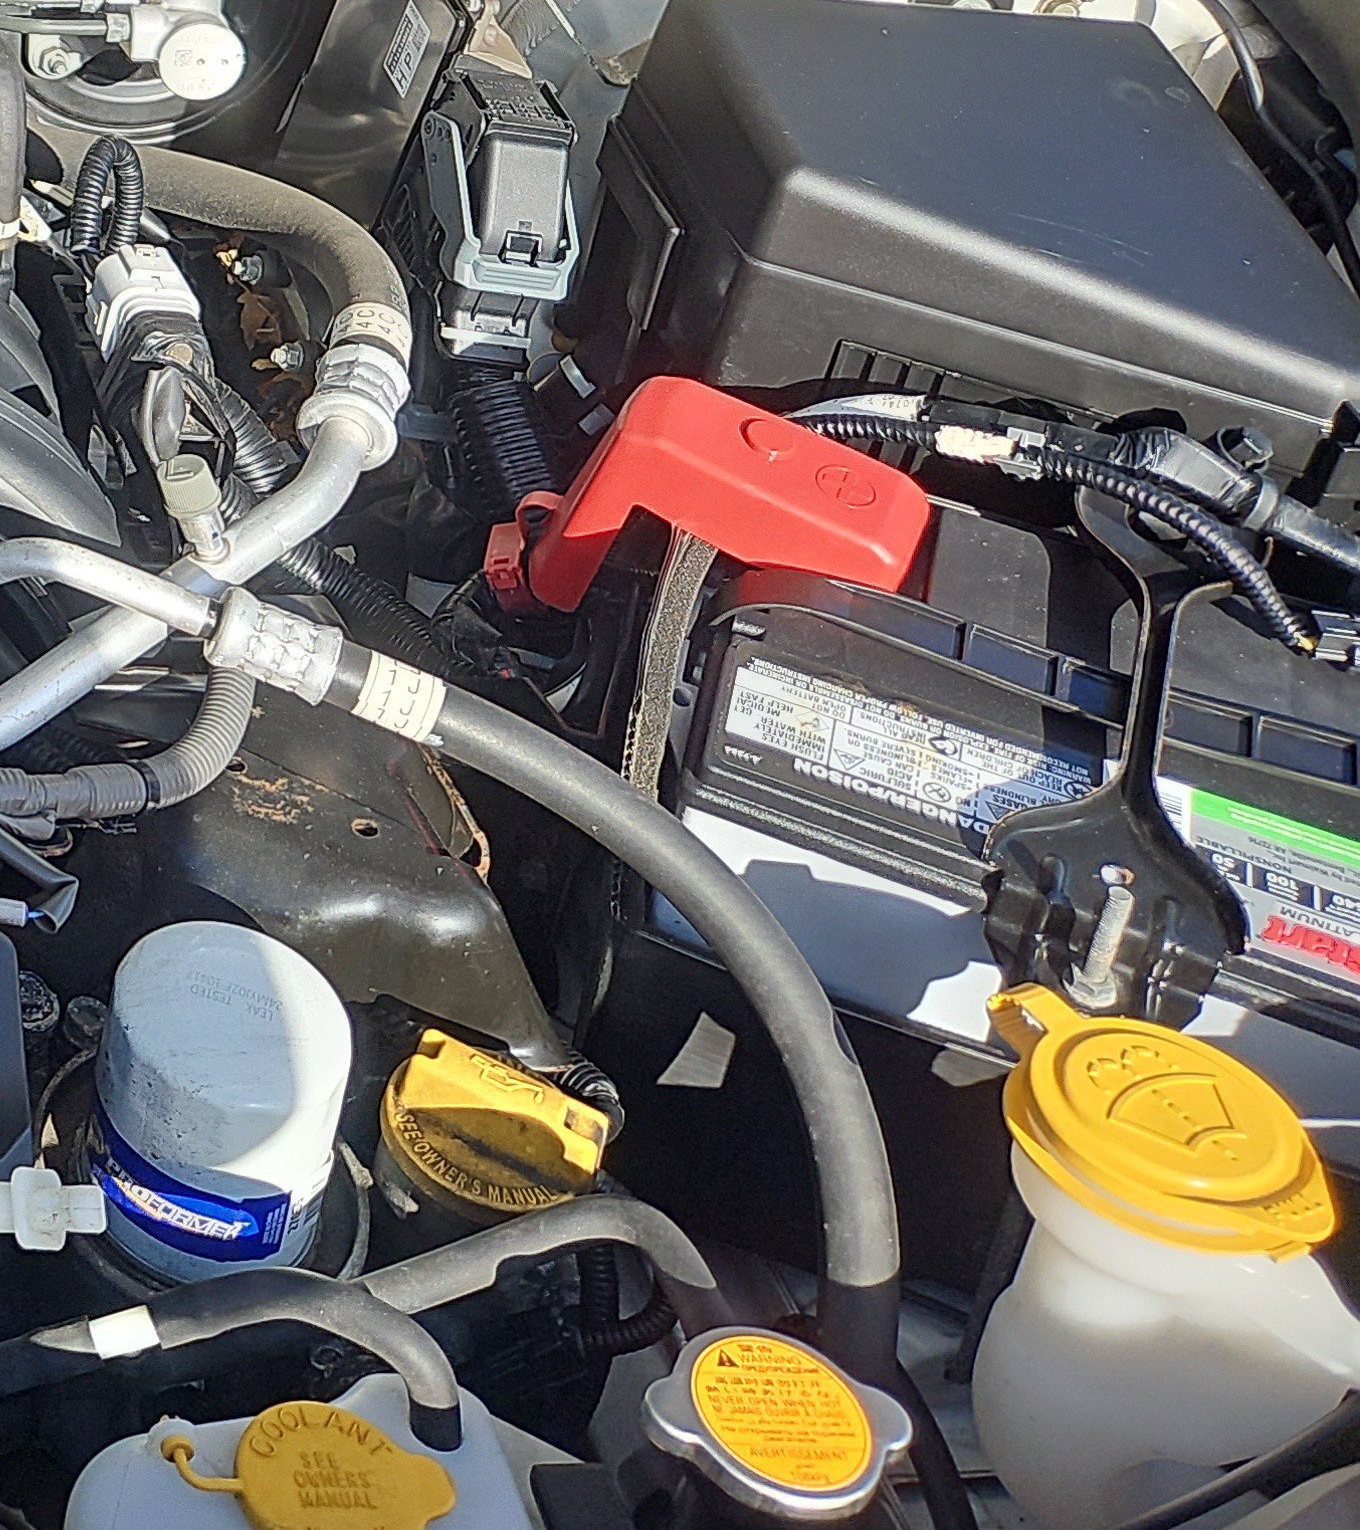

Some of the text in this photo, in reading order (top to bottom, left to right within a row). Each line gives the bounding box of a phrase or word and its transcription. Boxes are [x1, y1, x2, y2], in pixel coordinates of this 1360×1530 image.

[794, 678, 807, 689] OR
[811, 677, 854, 698] CHARGING
[766, 698, 793, 713] HELP
[809, 683, 864, 708] DISASSEMBLE
[821, 698, 846, 712] OPEN
[733, 702, 752, 716] GET
[735, 695, 780, 717] MEDICAL
[811, 702, 845, 719] DO NOT
[864, 702, 883, 715] NOT
[883, 709, 894, 719] DO
[753, 721, 825, 752] IMMEDIATELY
[799, 728, 826, 744] WITH
[882, 726, 898, 736] ALL
[929, 724, 941, 734] OR
[761, 732, 824, 760] FLUSH EYES
[880, 738, 916, 757] SEVERE
[942, 729, 988, 751] EXPLOSION
[985, 735, 1004, 748] FOR
[847, 737, 915, 766] BLINDNESS OR
[1004, 741, 1070, 770] RECOMMENDED
[862, 750, 913, 774] CAN CAUSE
[1070, 764, 1087, 776] NOT
[858, 766, 912, 791] SULFURIC
[886, 766, 912, 782] ACID
[982, 760, 1062, 792] KEEP OUT OF THE
[1030, 768, 1062, 785] REACH
[792, 756, 990, 837] DANGER/POISON
[1196, 835, 1292, 874] NONSPILLABLE
[1273, 844, 1286, 854] AR
[1287, 856, 1328, 876] Walmart
[1264, 870, 1299, 890] 100
[190, 984, 274, 1022] LEAK TESTED
[396, 1110, 558, 1206] SEE OWNER'S MANUAL
[250, 1406, 393, 1458] COOLANT
[299, 1450, 340, 1470] SEE
[298, 1490, 378, 1509] MANUAL
